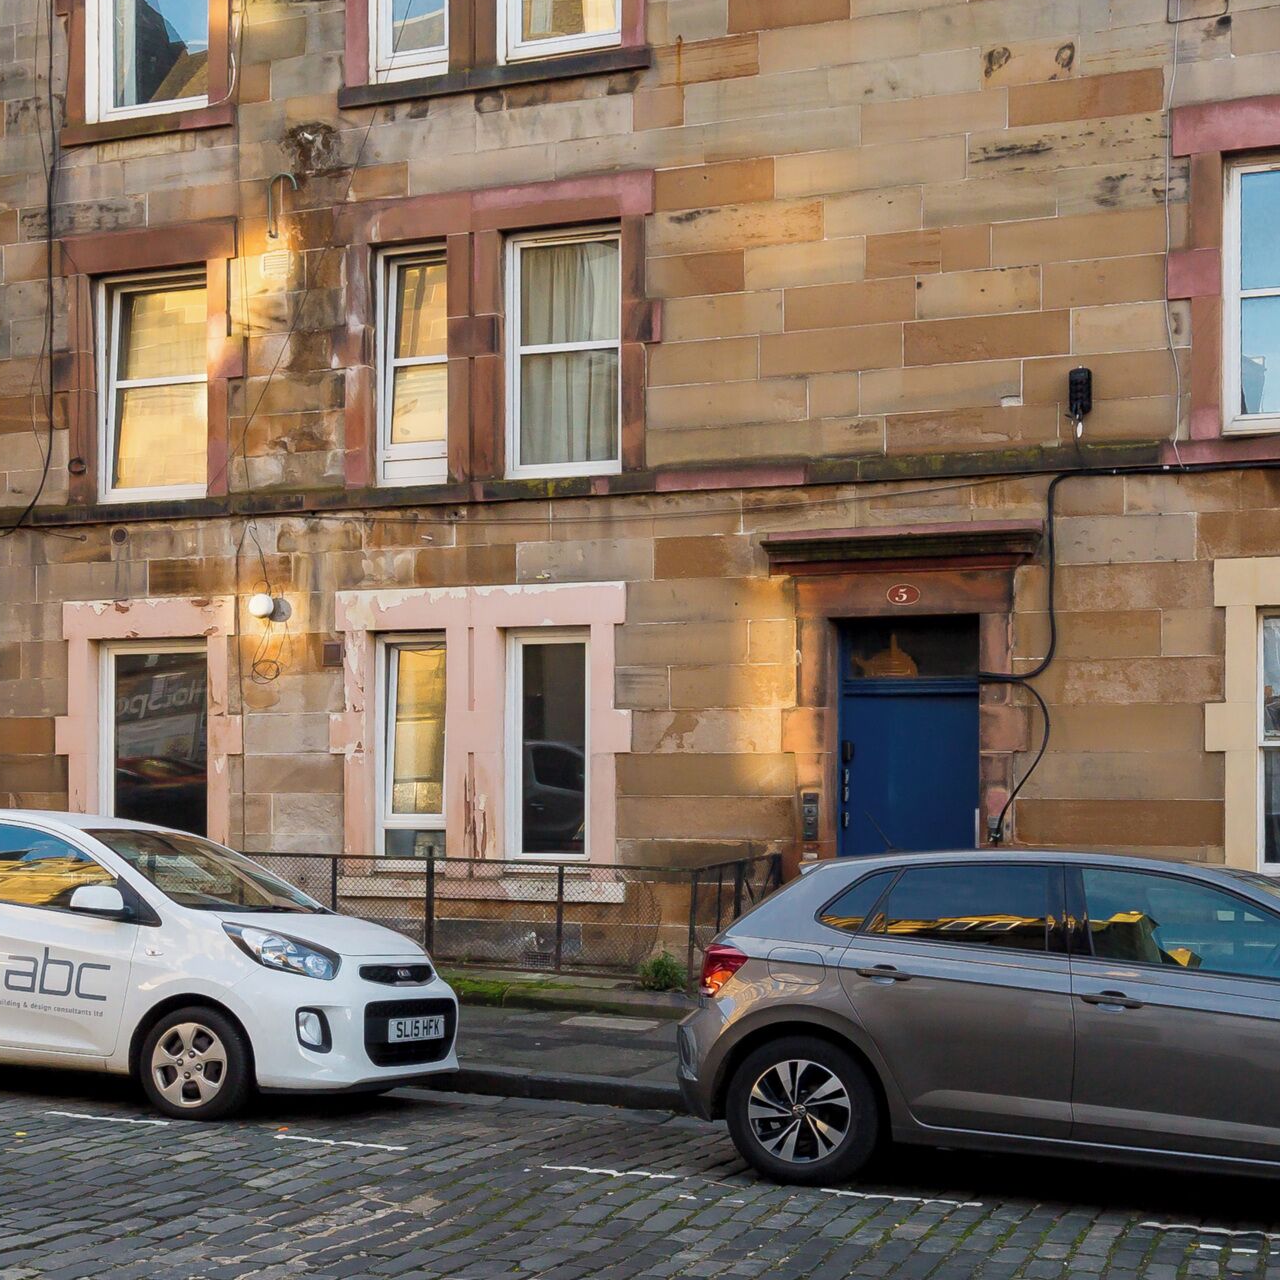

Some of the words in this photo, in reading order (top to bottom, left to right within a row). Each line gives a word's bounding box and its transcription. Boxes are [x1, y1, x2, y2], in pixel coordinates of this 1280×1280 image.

[895, 588, 908, 602] 5
[4, 947, 111, 1001] abc
[30, 1002, 52, 1011] design
[53, 1006, 92, 1016] consultants
[396, 1021, 420, 1038] SL15
[422, 1019, 440, 1036] HFK
